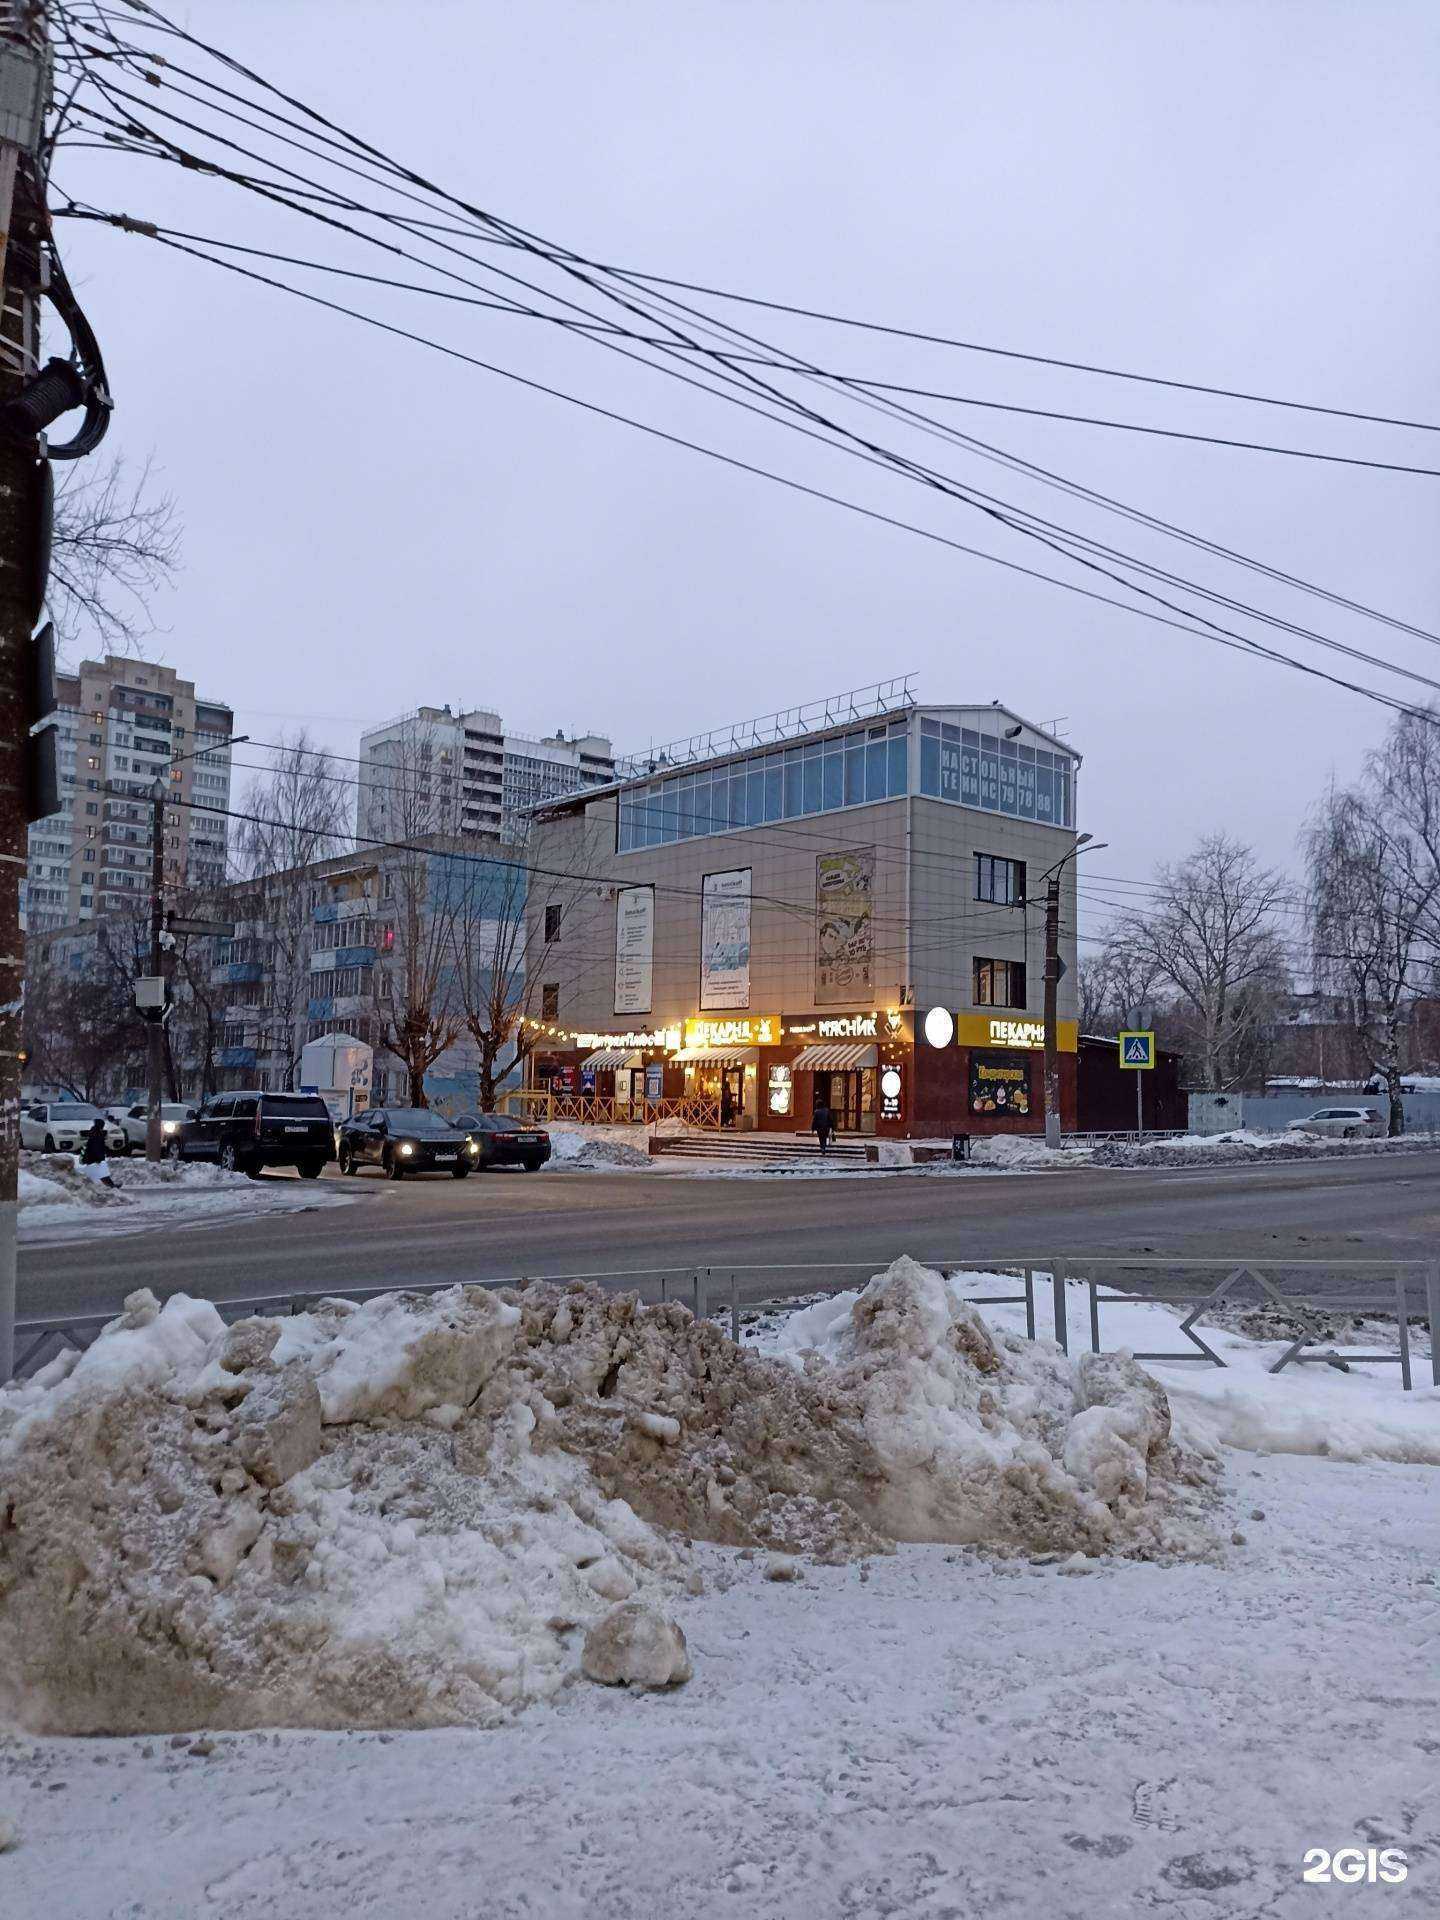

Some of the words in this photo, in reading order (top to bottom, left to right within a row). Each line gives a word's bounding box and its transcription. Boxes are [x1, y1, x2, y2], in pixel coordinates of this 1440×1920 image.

[942, 750, 1034, 789] НАСТОЛЬНЫЙ
[942, 771, 996, 799] ТЕННИС
[819, 1018, 877, 1037] МЯСНИК
